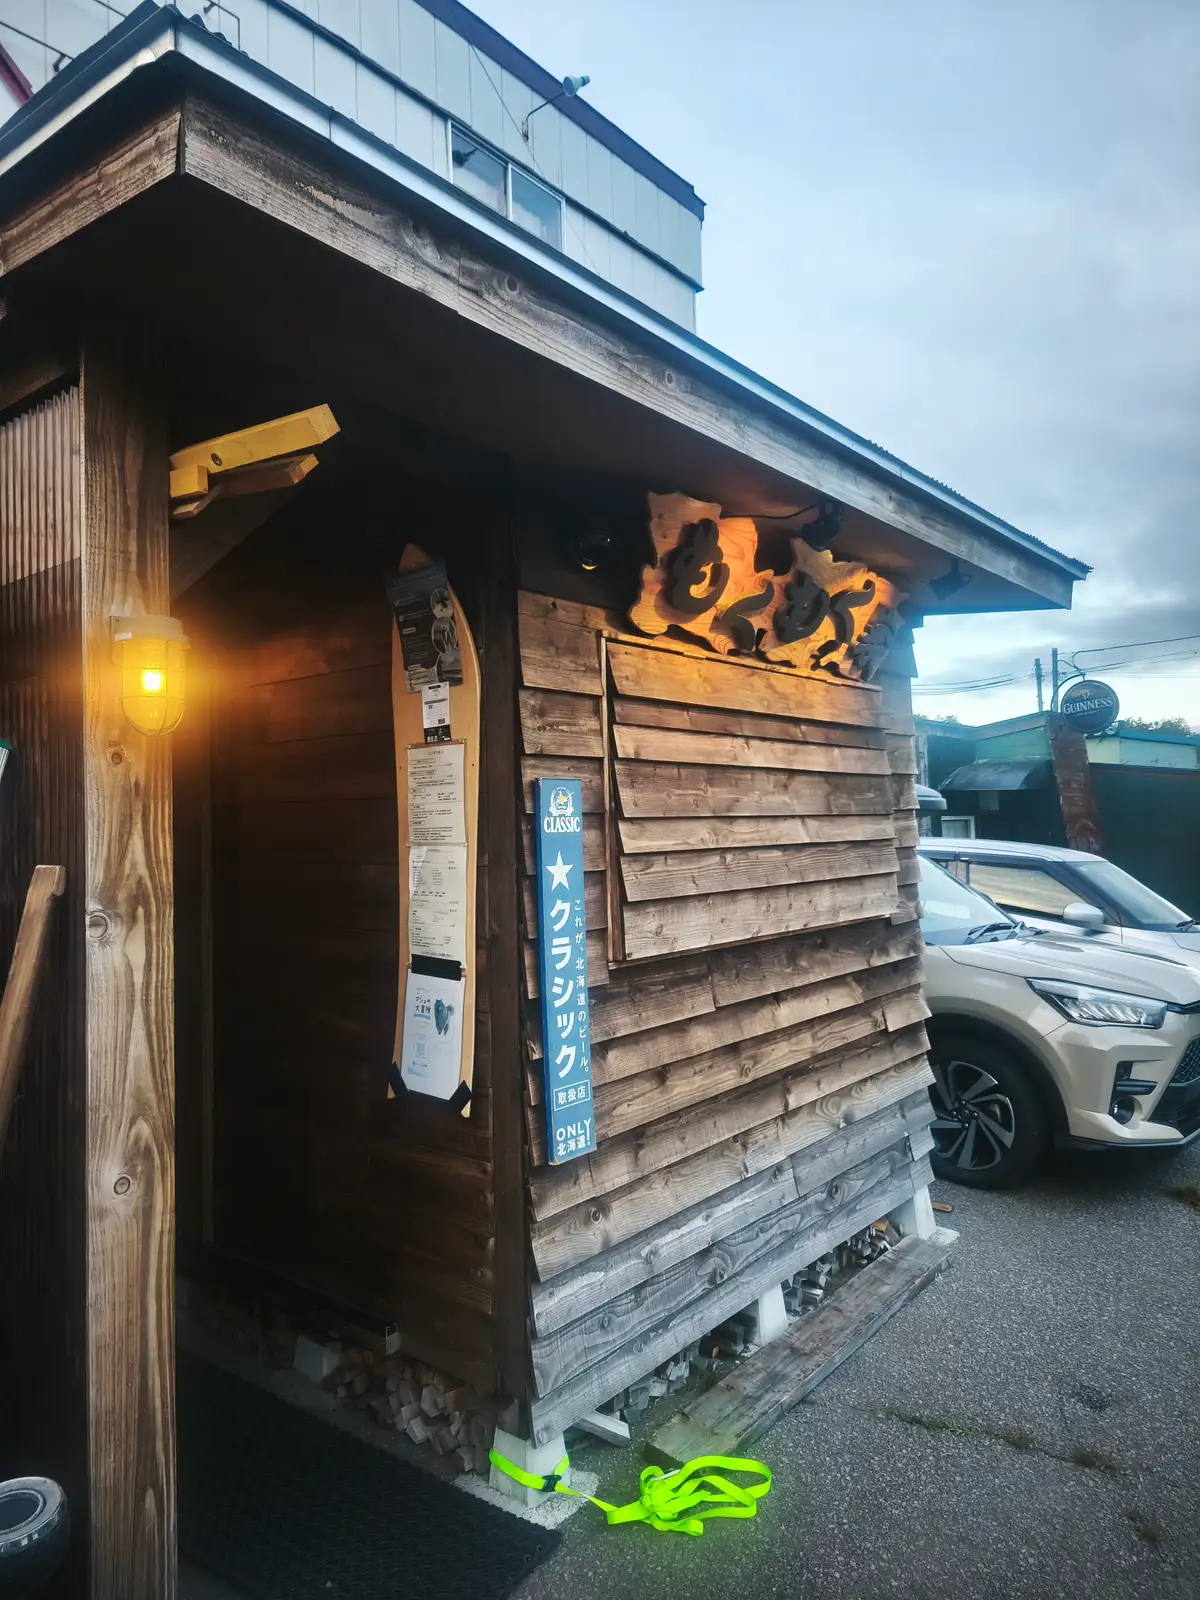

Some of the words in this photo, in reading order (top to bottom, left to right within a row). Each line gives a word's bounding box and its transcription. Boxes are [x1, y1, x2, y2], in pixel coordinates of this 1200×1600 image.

[1063, 697, 1114, 715] GUINNESS
[544, 816, 581, 833] CLASSIC
[549, 899, 577, 1079] クラシック
[574, 900, 589, 1072] これが、北海道のビール。
[557, 1086, 586, 1105] 取扱店
[556, 1118, 592, 1141] ONLY
